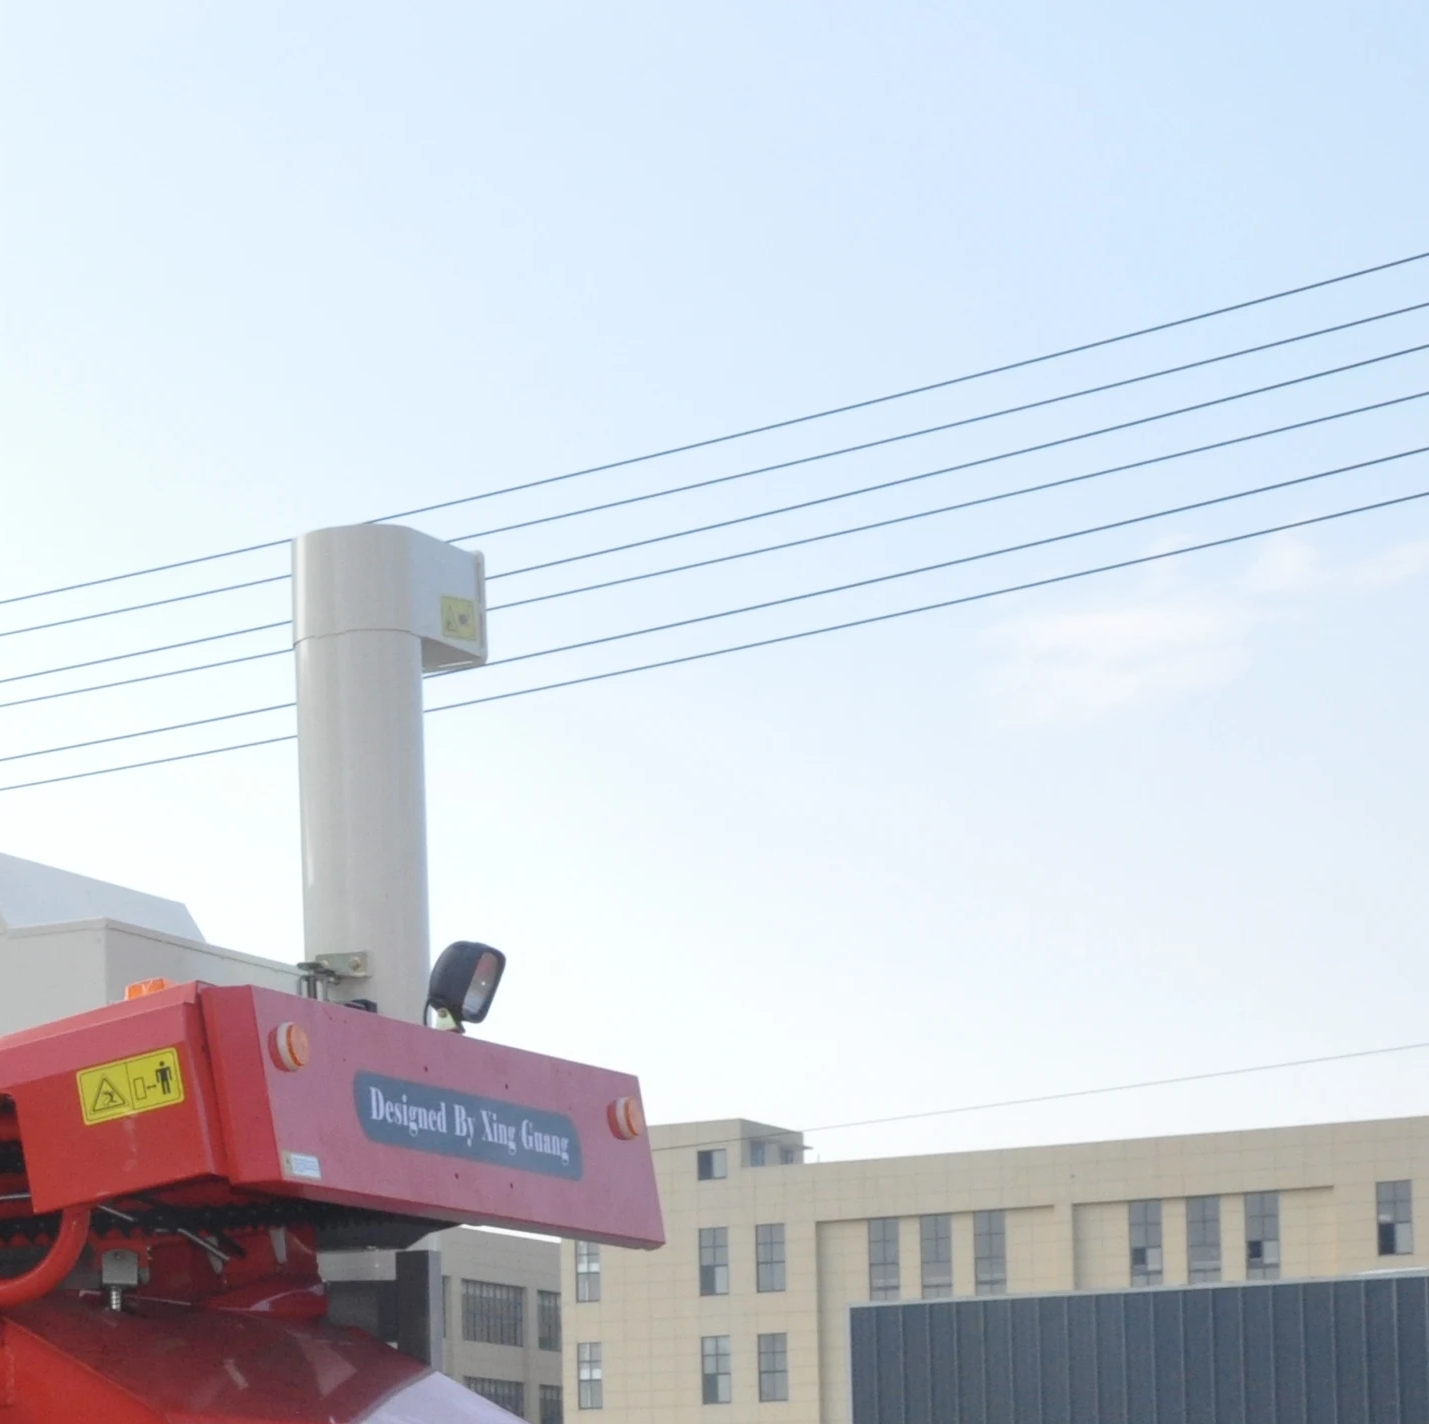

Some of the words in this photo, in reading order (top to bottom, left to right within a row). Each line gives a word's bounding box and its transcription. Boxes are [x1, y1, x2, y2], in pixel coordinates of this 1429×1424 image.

[369, 1086, 448, 1137] Designed
[453, 1104, 476, 1147] By
[480, 1109, 517, 1155] Xing
[521, 1118, 570, 1166] Guang
